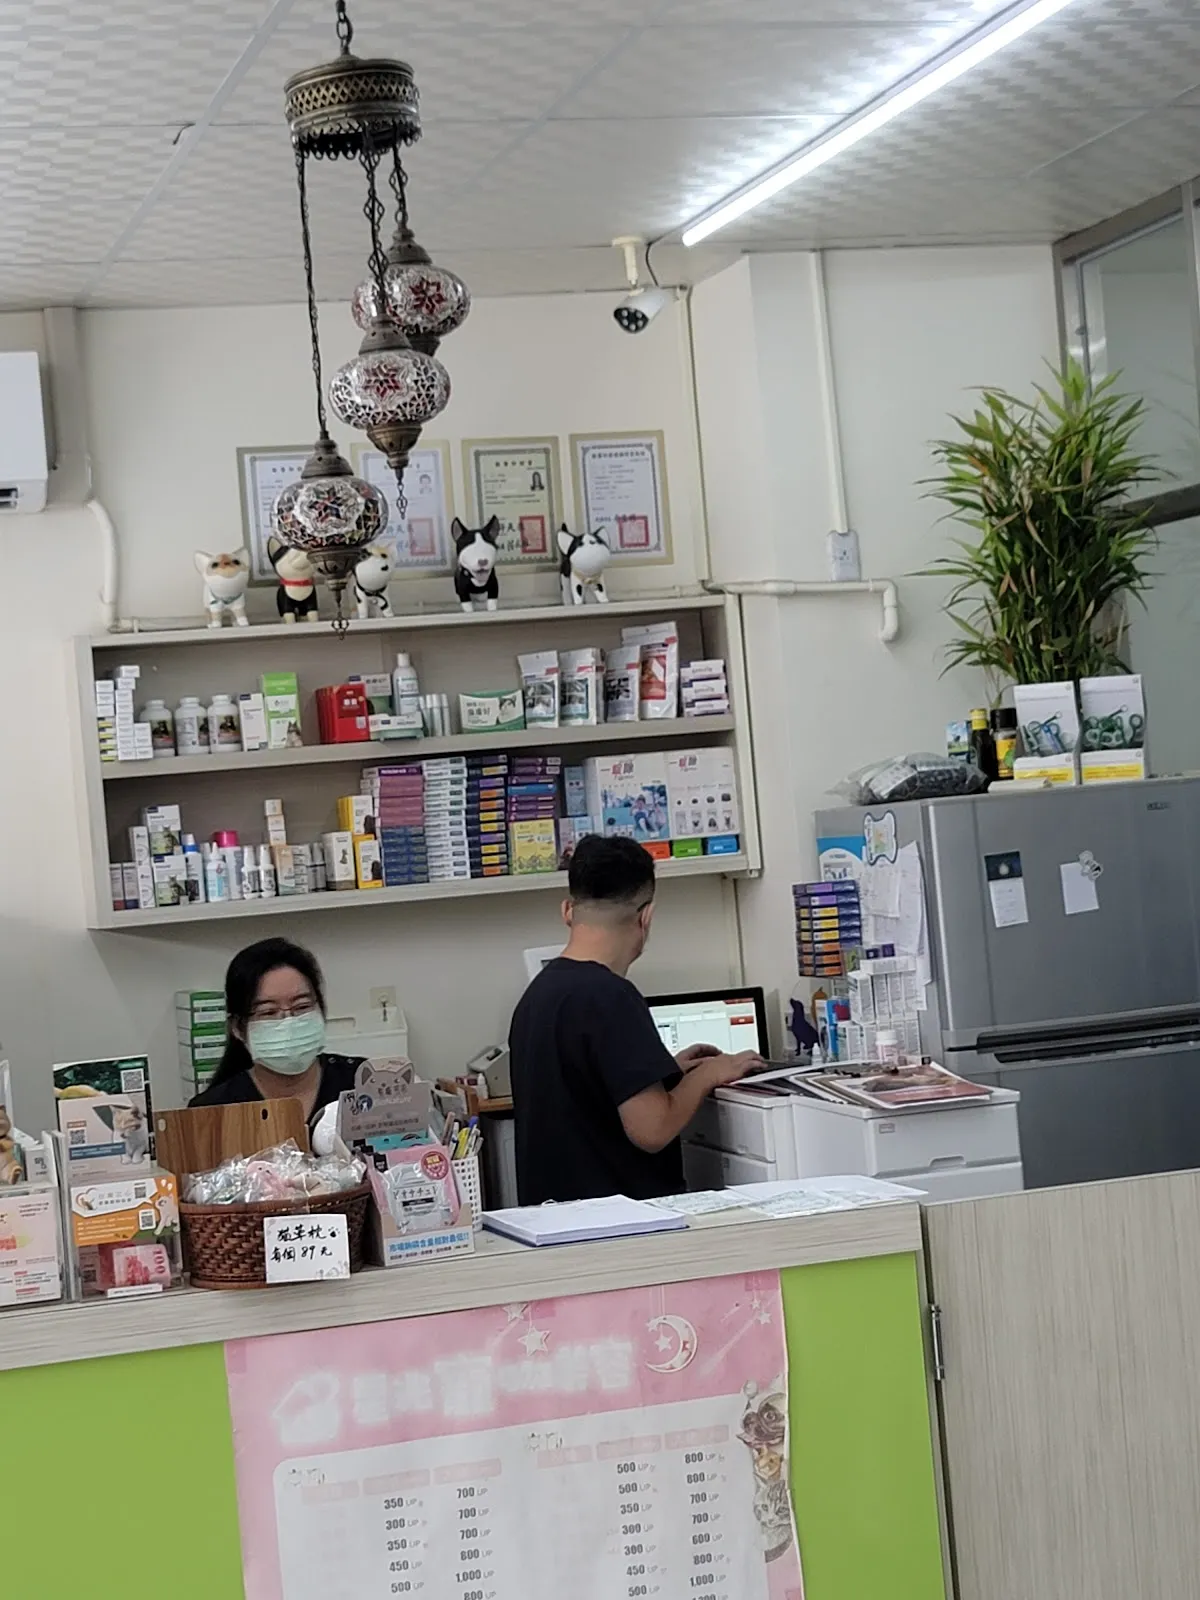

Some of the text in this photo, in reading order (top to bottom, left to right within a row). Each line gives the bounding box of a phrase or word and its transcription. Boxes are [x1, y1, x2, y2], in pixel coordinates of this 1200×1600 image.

[301, 1245, 316, 1260] 89
[685, 1452, 704, 1464] 800
[617, 1462, 636, 1474] 500
[686, 1472, 705, 1484] 800
[457, 1487, 475, 1499] 700
[618, 1482, 638, 1494] 500
[384, 1497, 404, 1510] 350
[690, 1492, 707, 1504] 700
[458, 1507, 476, 1520] 700
[620, 1503, 640, 1515] 350
[385, 1518, 405, 1530] 300
[692, 1512, 709, 1524] 700
[460, 1528, 478, 1540] 700
[622, 1523, 642, 1535] 300
[387, 1539, 407, 1551] 350
[624, 1544, 643, 1556] 300
[693, 1553, 712, 1565] 800
[389, 1560, 409, 1572] 450
[626, 1564, 645, 1576] 450
[391, 1581, 411, 1593] 500
[628, 1585, 647, 1597] 500
